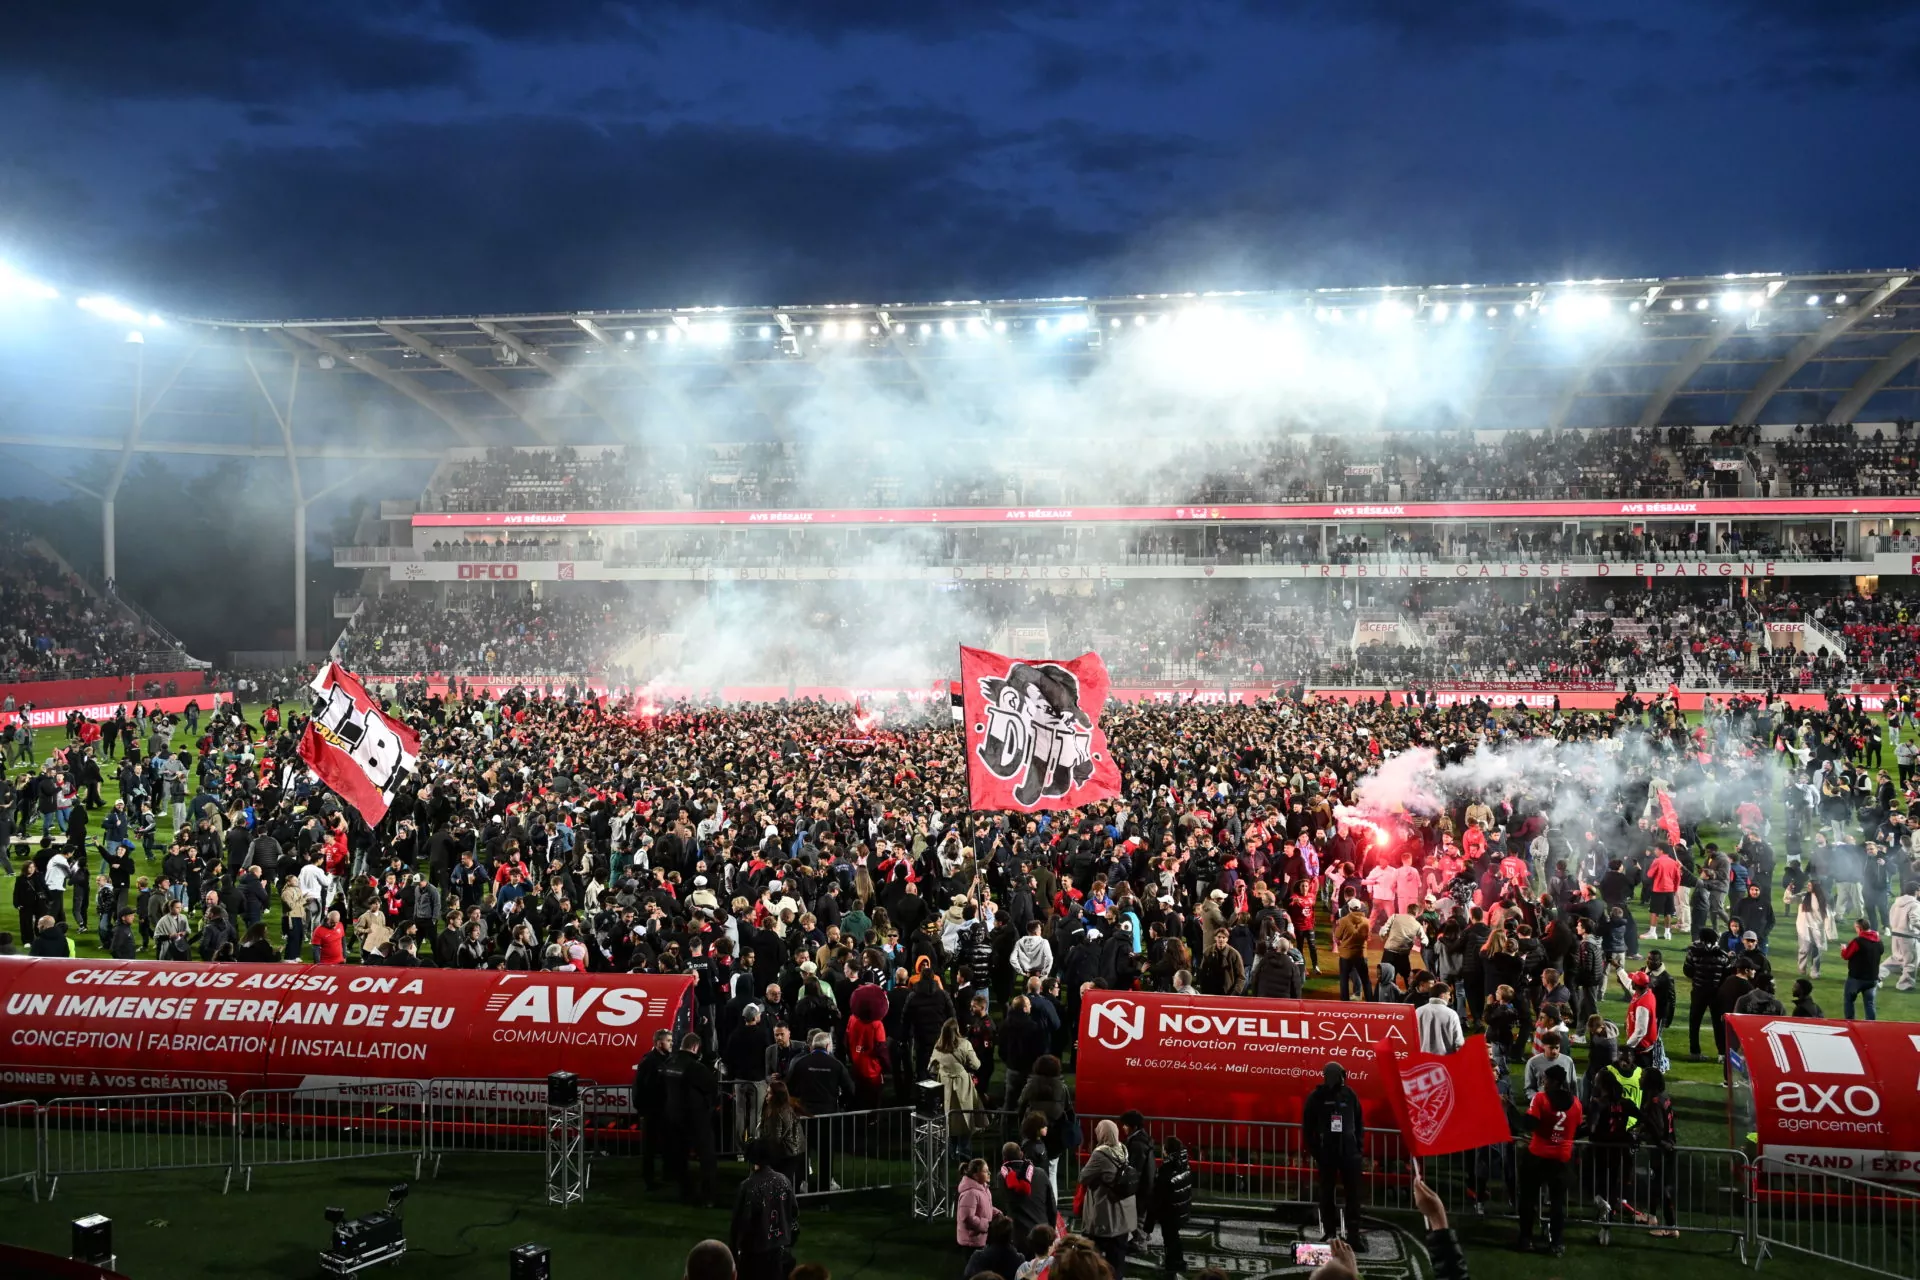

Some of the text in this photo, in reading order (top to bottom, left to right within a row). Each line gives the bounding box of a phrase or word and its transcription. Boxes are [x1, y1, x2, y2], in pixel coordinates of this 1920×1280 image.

[1006, 507, 1073, 519] AVS RÉSEAUX
[1334, 504, 1404, 515] AVS RÉSEAUX
[1622, 501, 1697, 512] AVS RÉSEAUX
[504, 513, 566, 523] AVS RÉSEAUX
[770, 511, 813, 521] RÉSEAUX
[458, 564, 518, 579] DFCO
[1300, 565, 1429, 577] TRIBUNE
[1455, 564, 1570, 577] CAISSE
[1369, 623, 1400, 632] CEBFC
[1772, 624, 1805, 632] CEBFC
[488, 675, 513, 685] UNIS
[515, 675, 543, 685] POUR
[66, 968, 423, 996] CHEZ NOUS AUSSI, ON A
[6, 993, 455, 1030] UN IMMENSE TERRAIN DE JEU
[498, 984, 648, 1027] AVS
[1317, 1010, 1405, 1022] maçonnerie
[492, 1029, 638, 1047] COMMUNICATION
[1158, 1013, 1408, 1045] NOVELLI.SALA
[12, 1029, 428, 1061] CONCEPTION FABRICATION INSTALLATION
[1158, 1037, 1409, 1062] rénovation ravalement de façes
[1124, 1057, 1143, 1068] Tél.
[1144, 1058, 1218, 1073] 06.07.84.50.44
[1225, 1063, 1249, 1075] Mail
[60, 1073, 85, 1086] VIE
[88, 1070, 102, 1087] À
[104, 1075, 136, 1088] VOS
[140, 1074, 229, 1092] CRÉATIONS
[338, 1081, 417, 1098] ENSEIGNE
[1776, 1081, 1880, 1117] axo
[1552, 1110, 1567, 1132] 2
[1778, 1117, 1885, 1135] agencement
[1783, 1152, 1854, 1170] STAND
